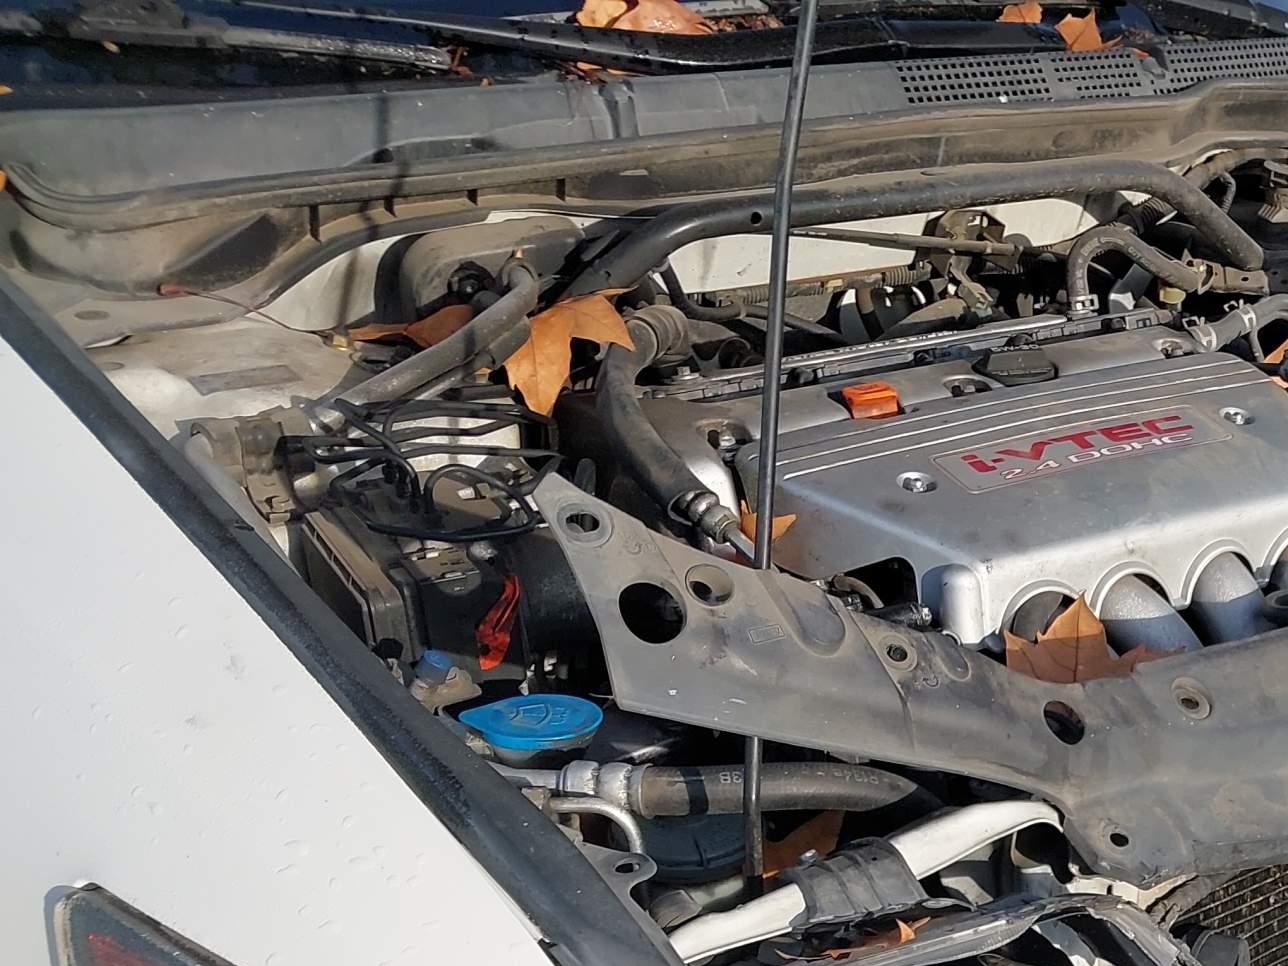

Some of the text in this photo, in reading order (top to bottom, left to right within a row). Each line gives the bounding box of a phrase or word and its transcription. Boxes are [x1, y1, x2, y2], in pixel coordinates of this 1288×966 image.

[961, 415, 1194, 473] i-VTEC
[1001, 433, 1193, 480] 2.4 DOHC
